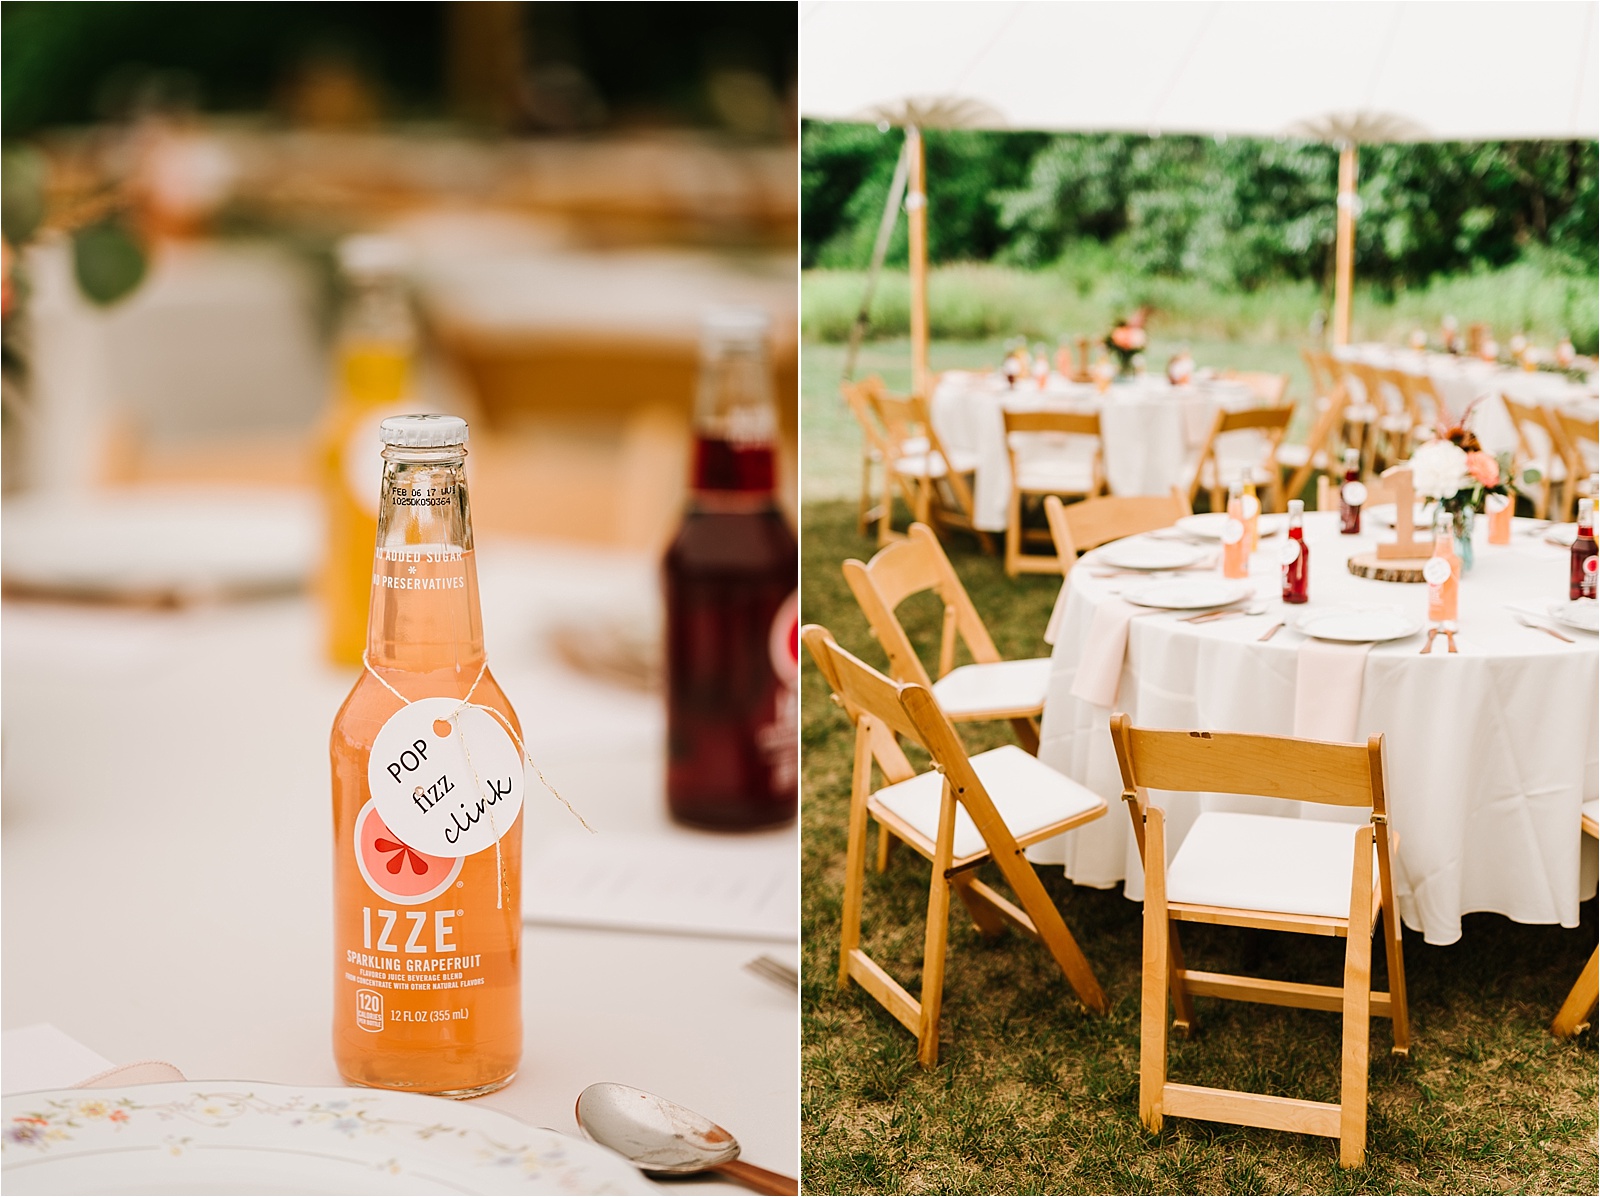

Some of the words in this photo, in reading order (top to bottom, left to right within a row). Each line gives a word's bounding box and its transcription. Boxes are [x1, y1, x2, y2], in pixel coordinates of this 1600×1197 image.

[392, 487, 407, 496] FEB
[411, 488, 422, 497] 06
[426, 488, 436, 497] 17
[385, 550, 420, 563] ADDED
[426, 550, 462, 563] SUGAR
[382, 576, 464, 590] PRESERVATIVES
[386, 739, 428, 784] POP
[412, 775, 455, 814] fizz
[445, 776, 512, 844] clink
[363, 907, 457, 953] IZZE
[346, 950, 401, 972] SPARKLING
[406, 954, 481, 972] GRAPEFRUIT
[356, 976, 392, 989] CONCENTRATE
[393, 982, 409, 990] WITH
[410, 983, 431, 991] OTHER
[432, 981, 459, 990] NATURAL
[460, 977, 485, 988] FLAVORS
[388, 973, 405, 982] JUICE
[407, 974, 441, 982] BEVERAGE
[442, 972, 463, 981] BLEND
[359, 993, 379, 1013] 120
[390, 1010, 402, 1022] 12
[429, 1010, 451, 1023] (355
[452, 1007, 469, 1020] mL)
